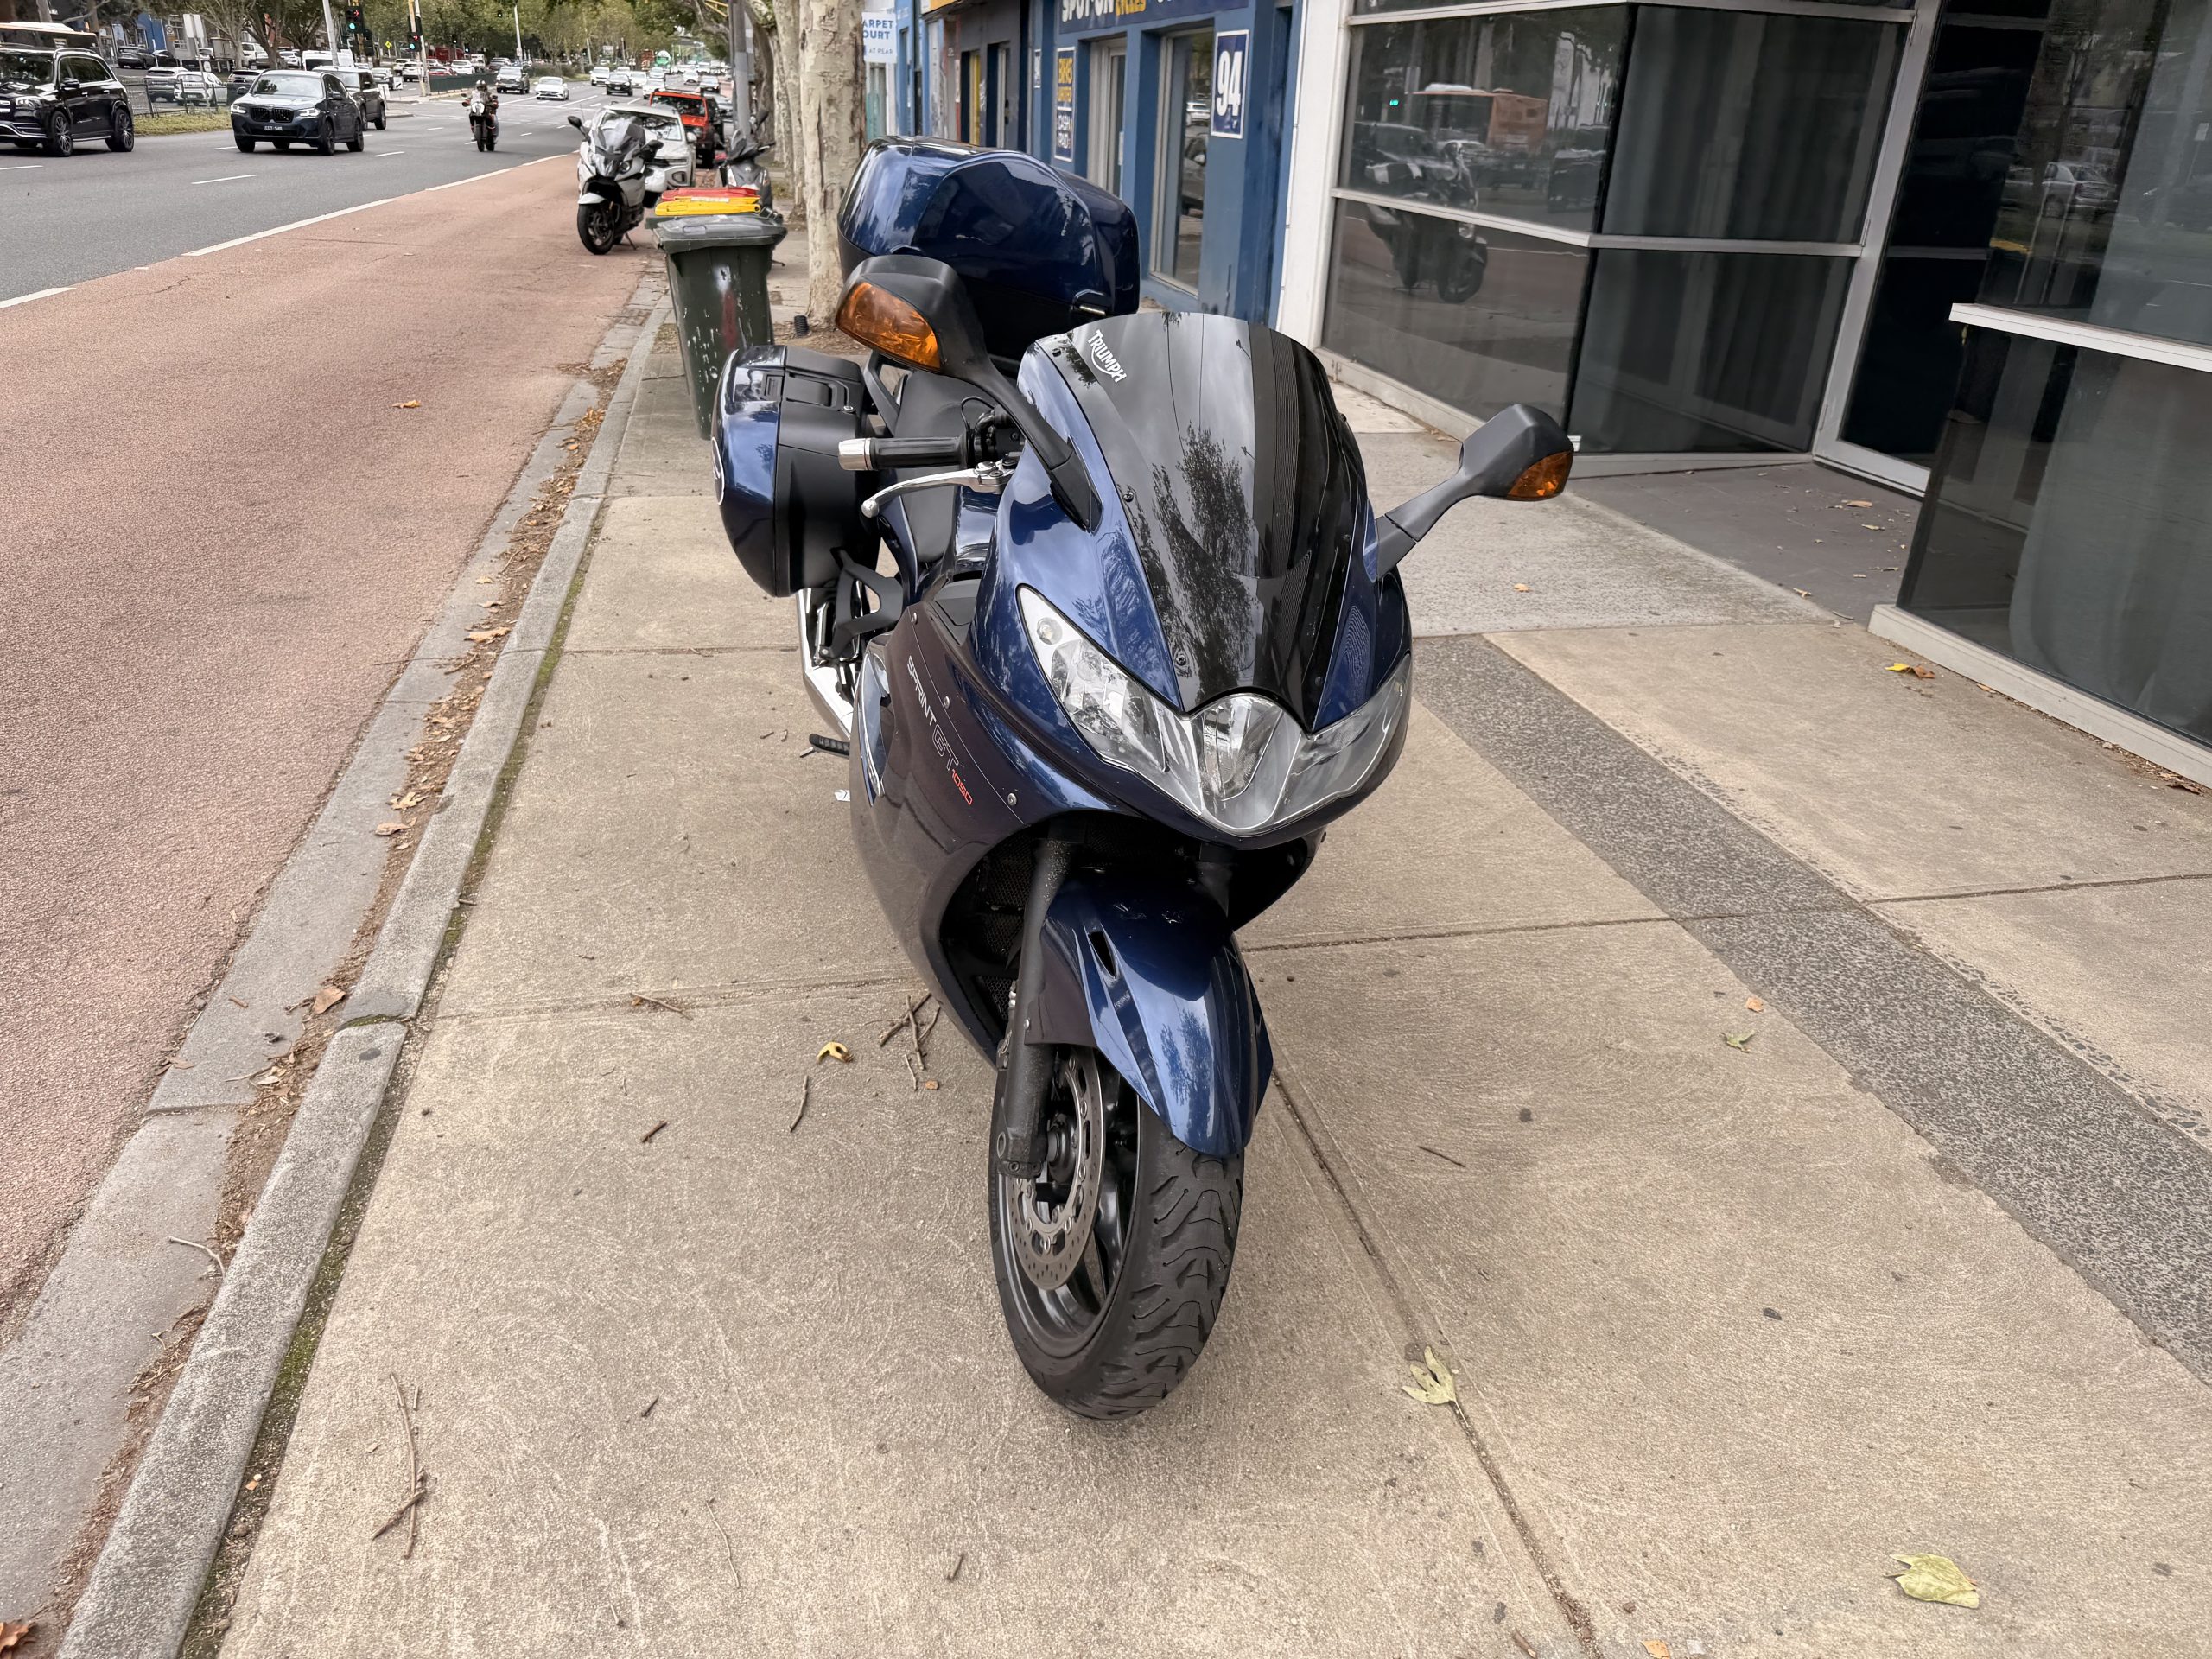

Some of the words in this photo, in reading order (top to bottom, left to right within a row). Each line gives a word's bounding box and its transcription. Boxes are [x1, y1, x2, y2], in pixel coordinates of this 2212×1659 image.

[863, 19, 893, 29] ARPET
[863, 29, 890, 39] OURT
[1217, 50, 1243, 116] 94
[1088, 329, 1127, 383] TRIUMPH
[907, 655, 937, 726] SPRINT
[932, 724, 959, 771] GT
[952, 769, 973, 805] 1050
